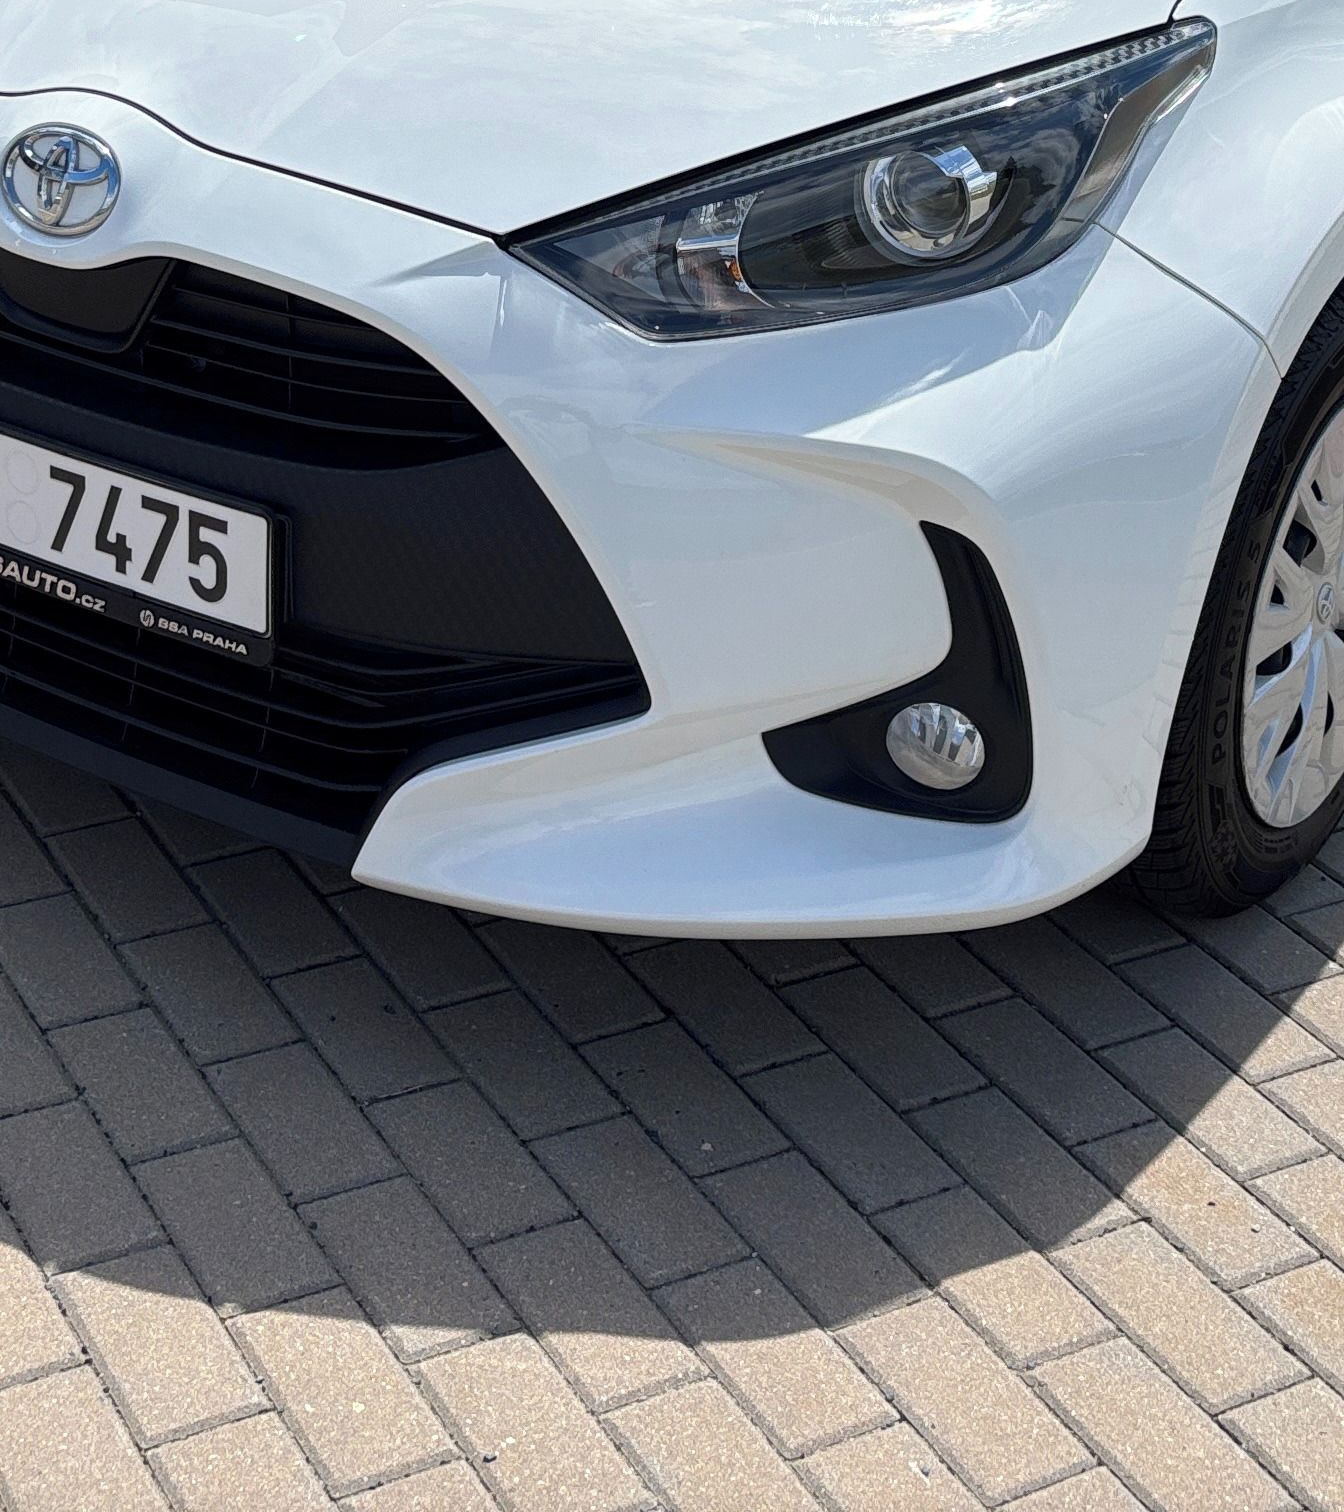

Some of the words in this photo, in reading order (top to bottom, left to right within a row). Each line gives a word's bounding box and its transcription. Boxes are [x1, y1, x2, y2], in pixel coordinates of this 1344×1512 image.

[49, 465, 229, 603] 7475
[158, 617, 190, 637] BSA
[192, 628, 249, 656] PRAHA
[1211, 580, 1251, 765] POLARIS
